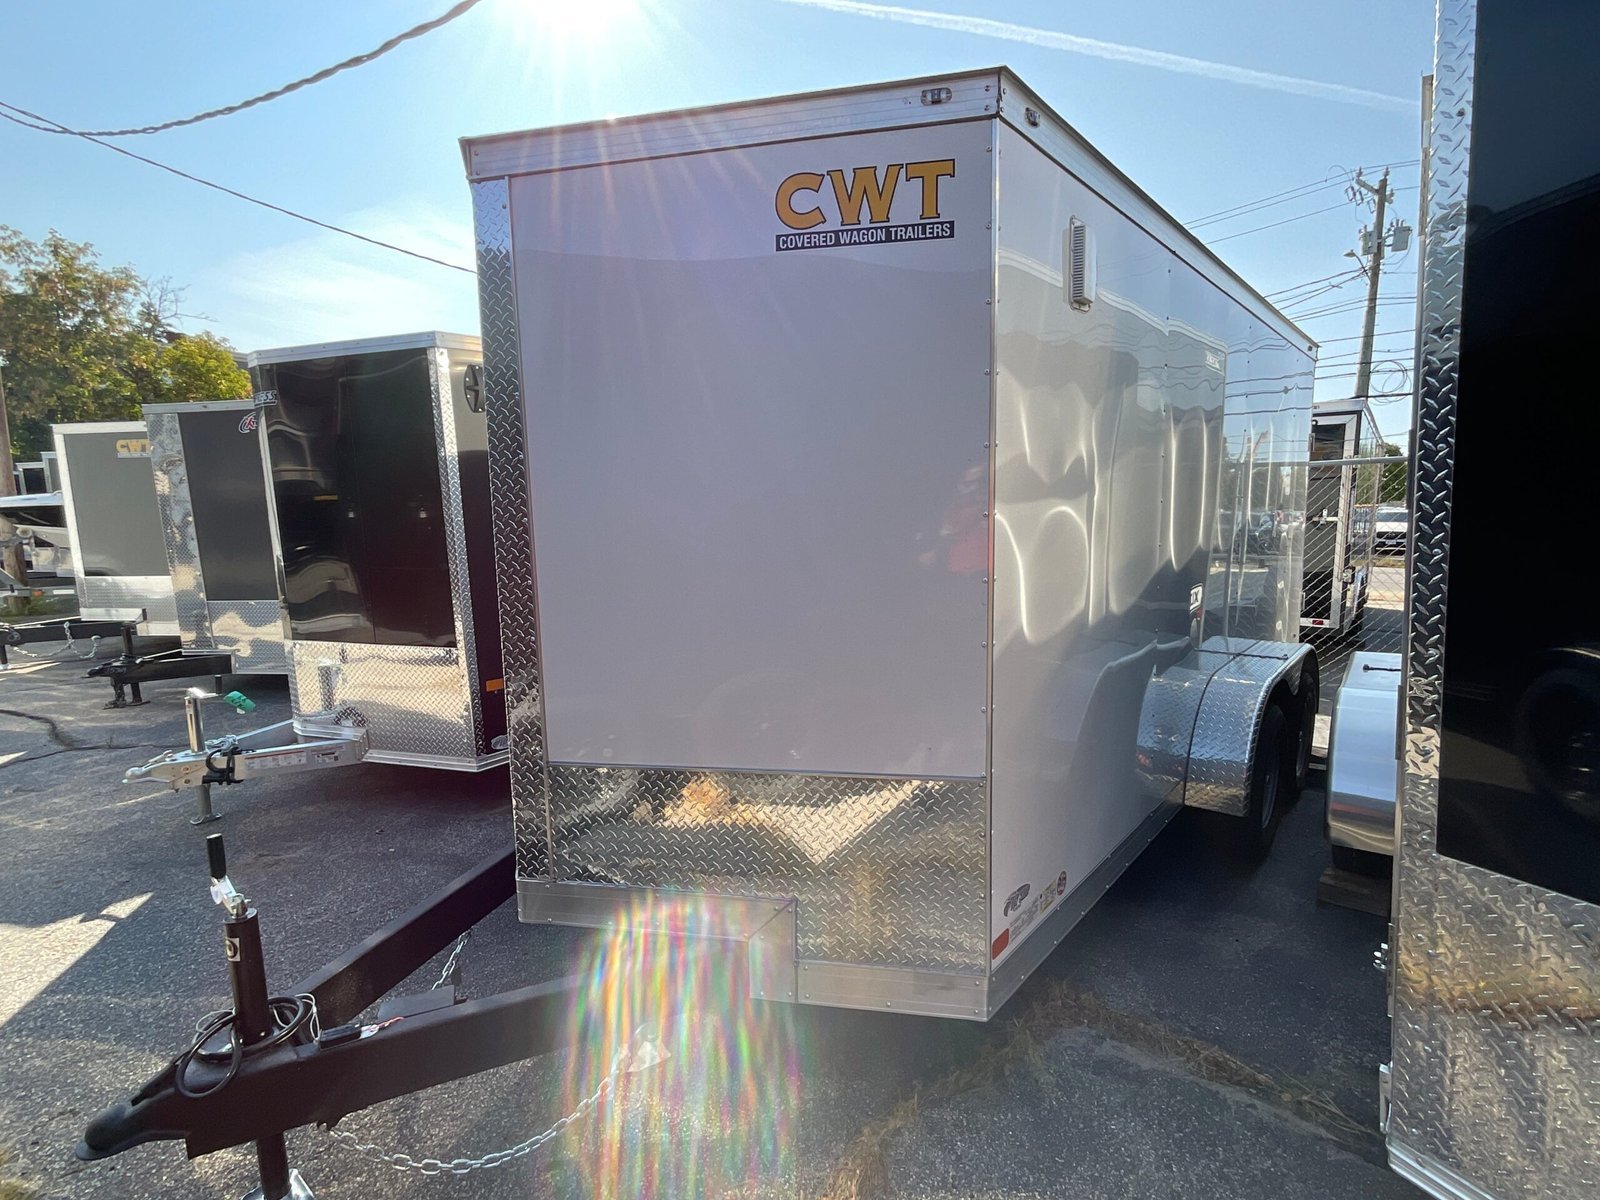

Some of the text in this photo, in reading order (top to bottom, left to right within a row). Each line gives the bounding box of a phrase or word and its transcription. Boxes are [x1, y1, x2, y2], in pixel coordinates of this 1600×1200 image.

[775, 159, 956, 231] CWT
[779, 223, 951, 249] COVERED WAGON TRAILERS
